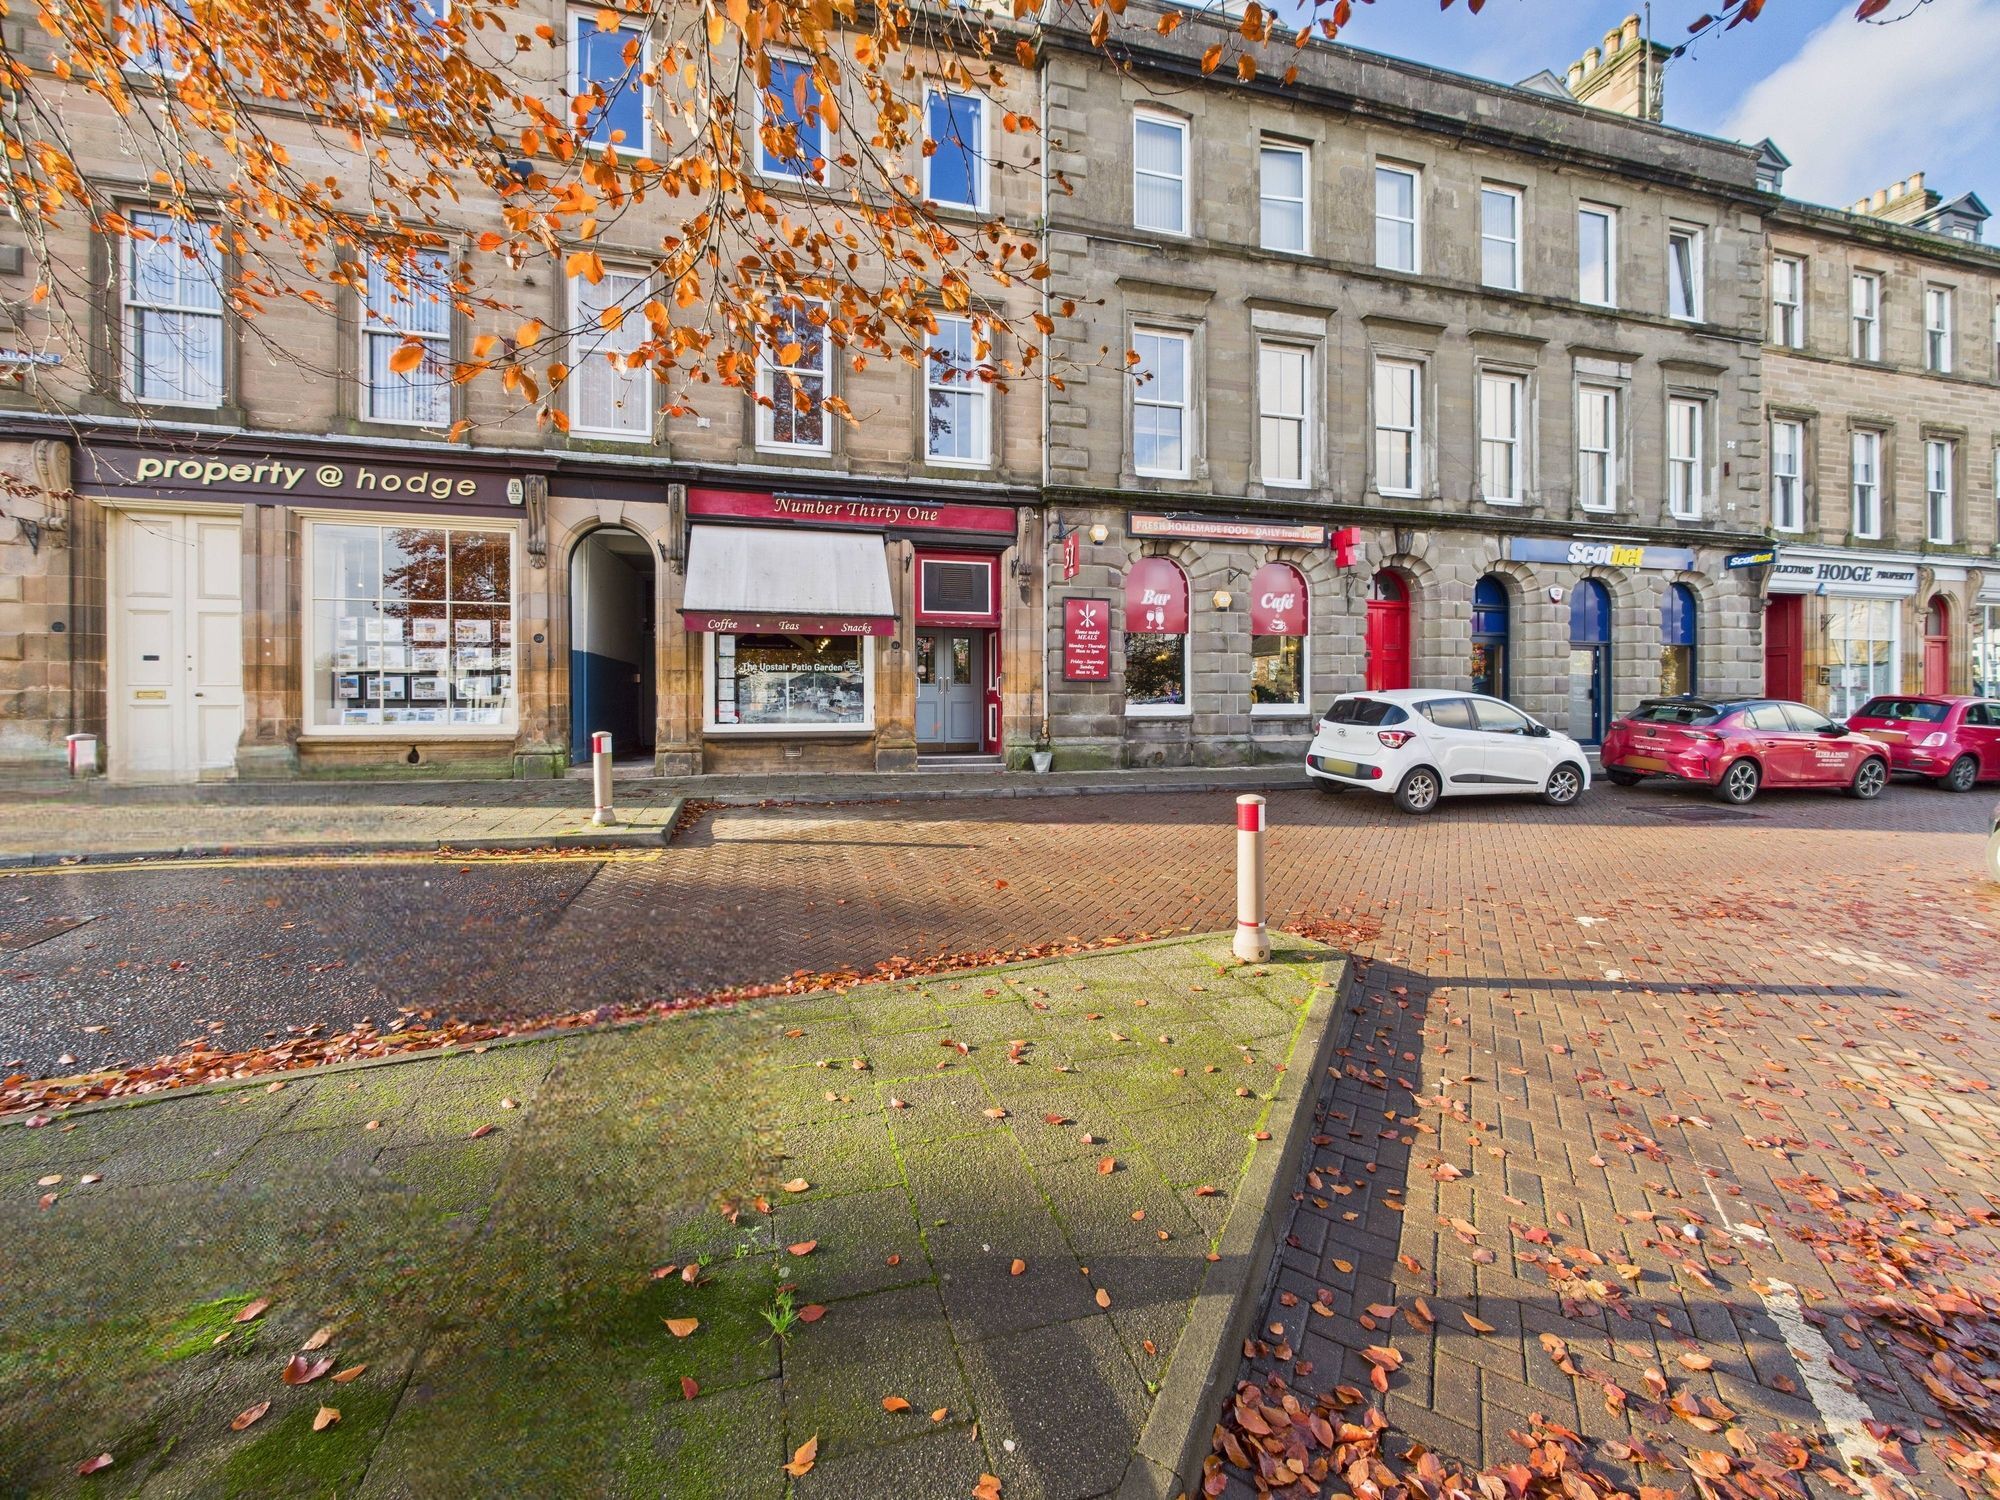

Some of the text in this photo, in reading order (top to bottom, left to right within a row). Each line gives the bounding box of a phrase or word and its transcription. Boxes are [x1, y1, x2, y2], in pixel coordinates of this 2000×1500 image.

[136, 457, 477, 500] property @ hodge
[774, 498, 938, 523] Number Thirty One
[1135, 521, 1166, 530] FRESH
[1167, 522, 1222, 533] HOMEMADE
[1223, 525, 1248, 534] FOOD
[1255, 527, 1281, 537] DAILY
[1064, 545, 1075, 569] 31
[1568, 541, 1645, 566] Scotbet
[1730, 552, 1774, 566] Scotbet
[1816, 564, 1873, 582] HODGE
[1876, 571, 1915, 580] PROPERTY
[1140, 589, 1171, 606] Bar
[1260, 592, 1295, 612] Café
[707, 619, 872, 633] Coffee Teas Snacks
[742, 662, 757, 671] The
[760, 663, 789, 672] Upstair
[791, 663, 812, 671] Patio
[814, 663, 843, 672] Garden
